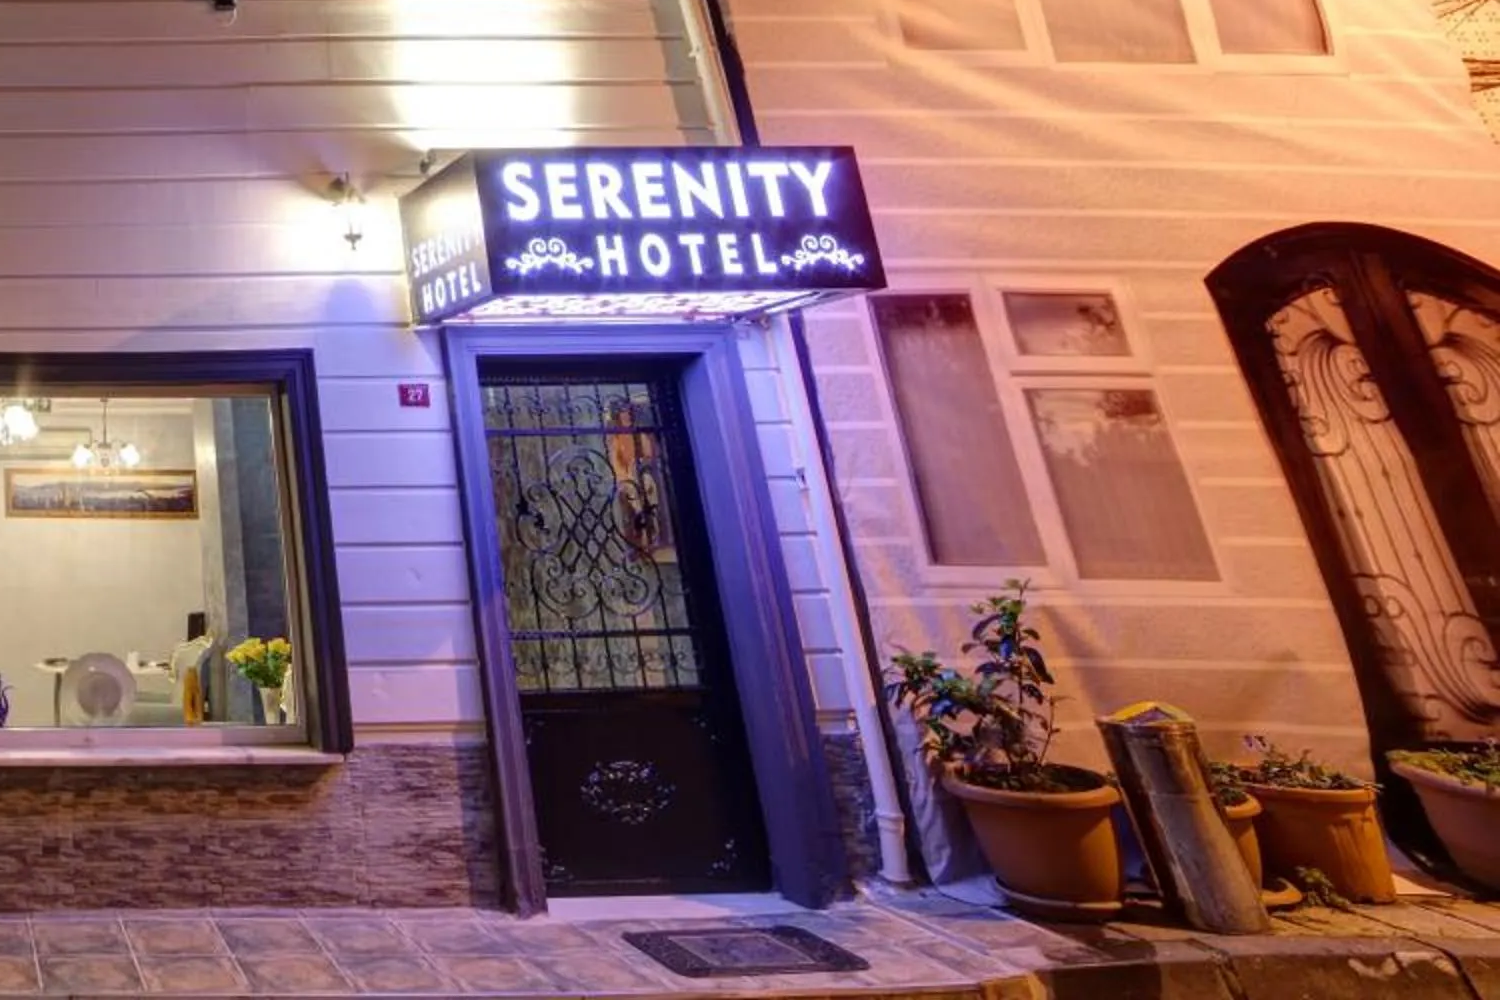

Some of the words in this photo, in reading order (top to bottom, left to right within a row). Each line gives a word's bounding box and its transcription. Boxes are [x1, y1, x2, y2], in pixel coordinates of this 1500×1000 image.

[501, 160, 833, 221] SERENITY
[411, 228, 482, 279] SERENIT
[596, 232, 779, 278] HOTEL
[421, 260, 483, 315] HOTEL
